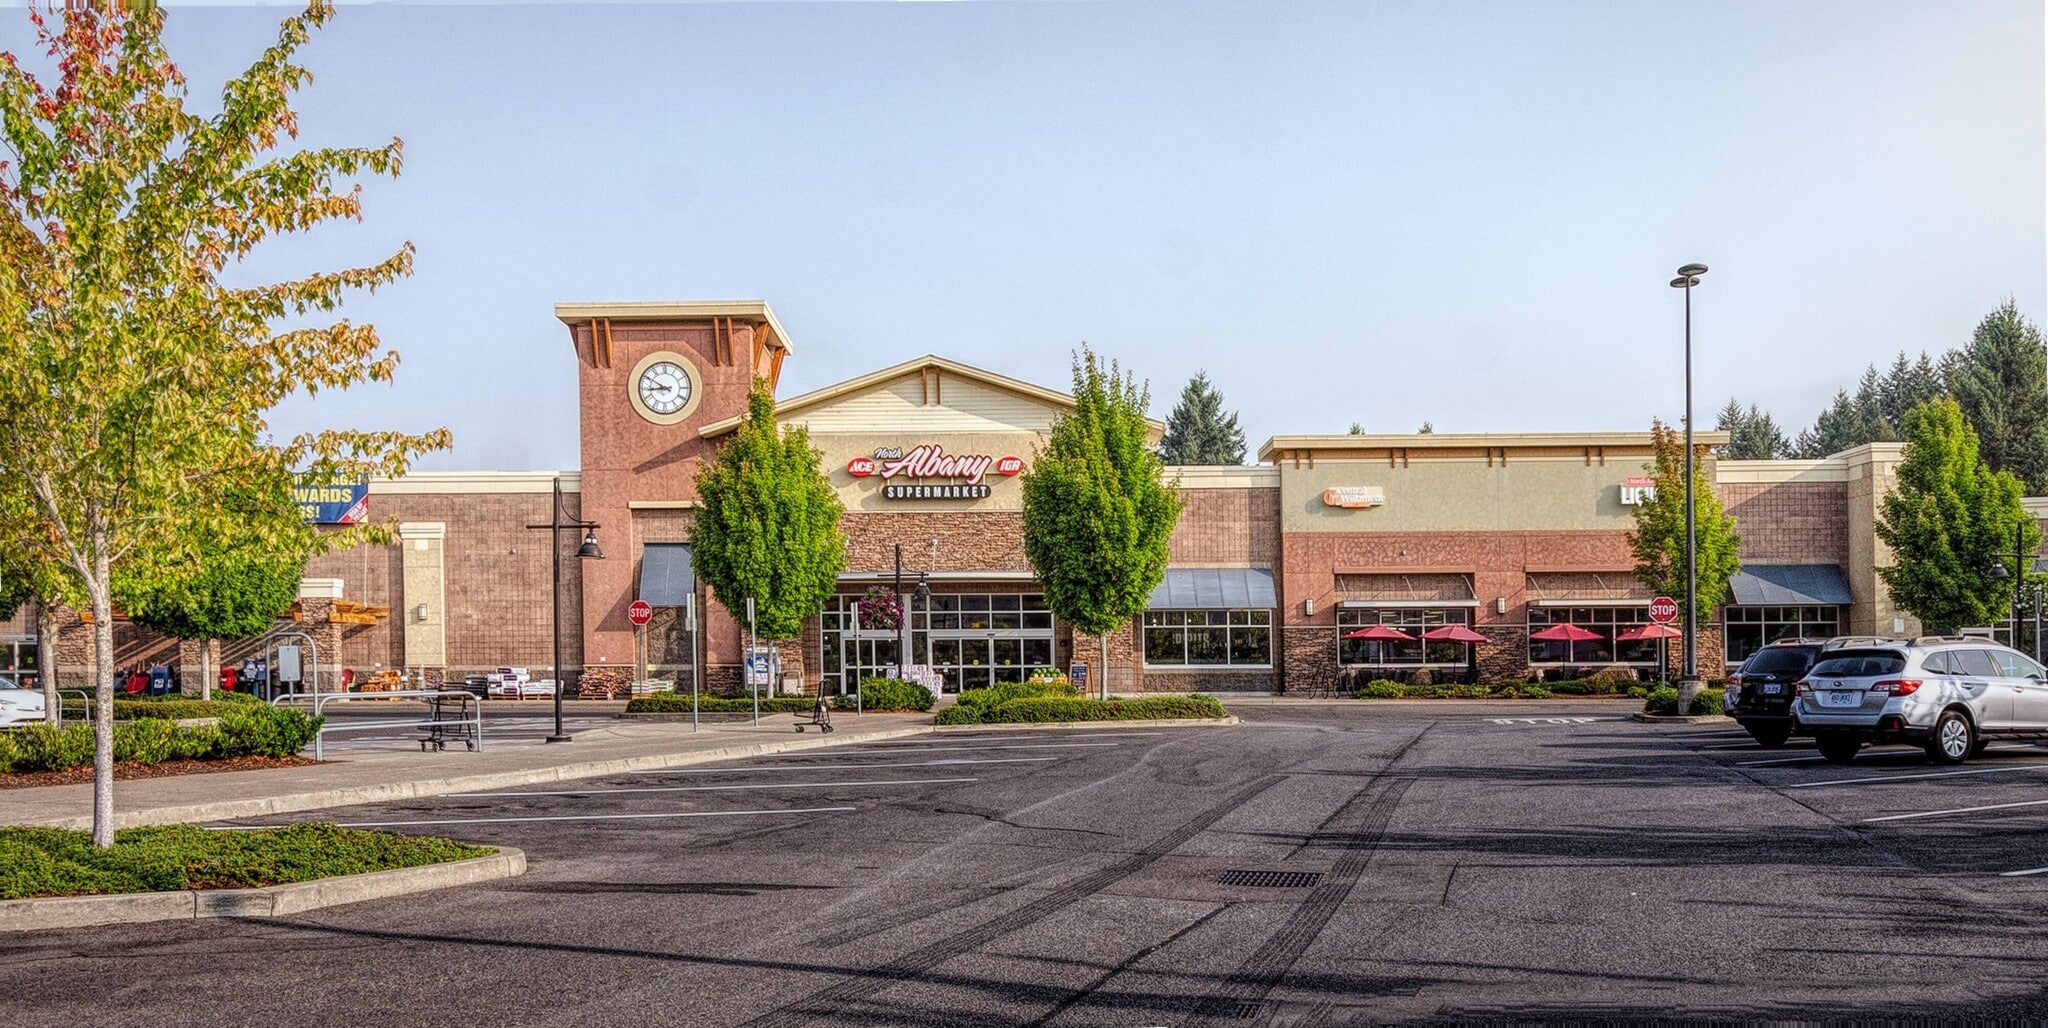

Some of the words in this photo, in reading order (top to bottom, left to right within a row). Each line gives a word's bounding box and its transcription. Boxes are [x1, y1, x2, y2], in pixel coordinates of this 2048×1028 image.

[874, 447, 902, 459] North
[850, 461, 873, 472] ACE
[881, 444, 992, 485] Albany
[1000, 460, 1020, 471] IGA
[291, 488, 352, 503] WARDS
[887, 486, 987, 498] SUPERMARKET
[630, 607, 650, 618] STOP
[1651, 605, 1676, 615] STOP
